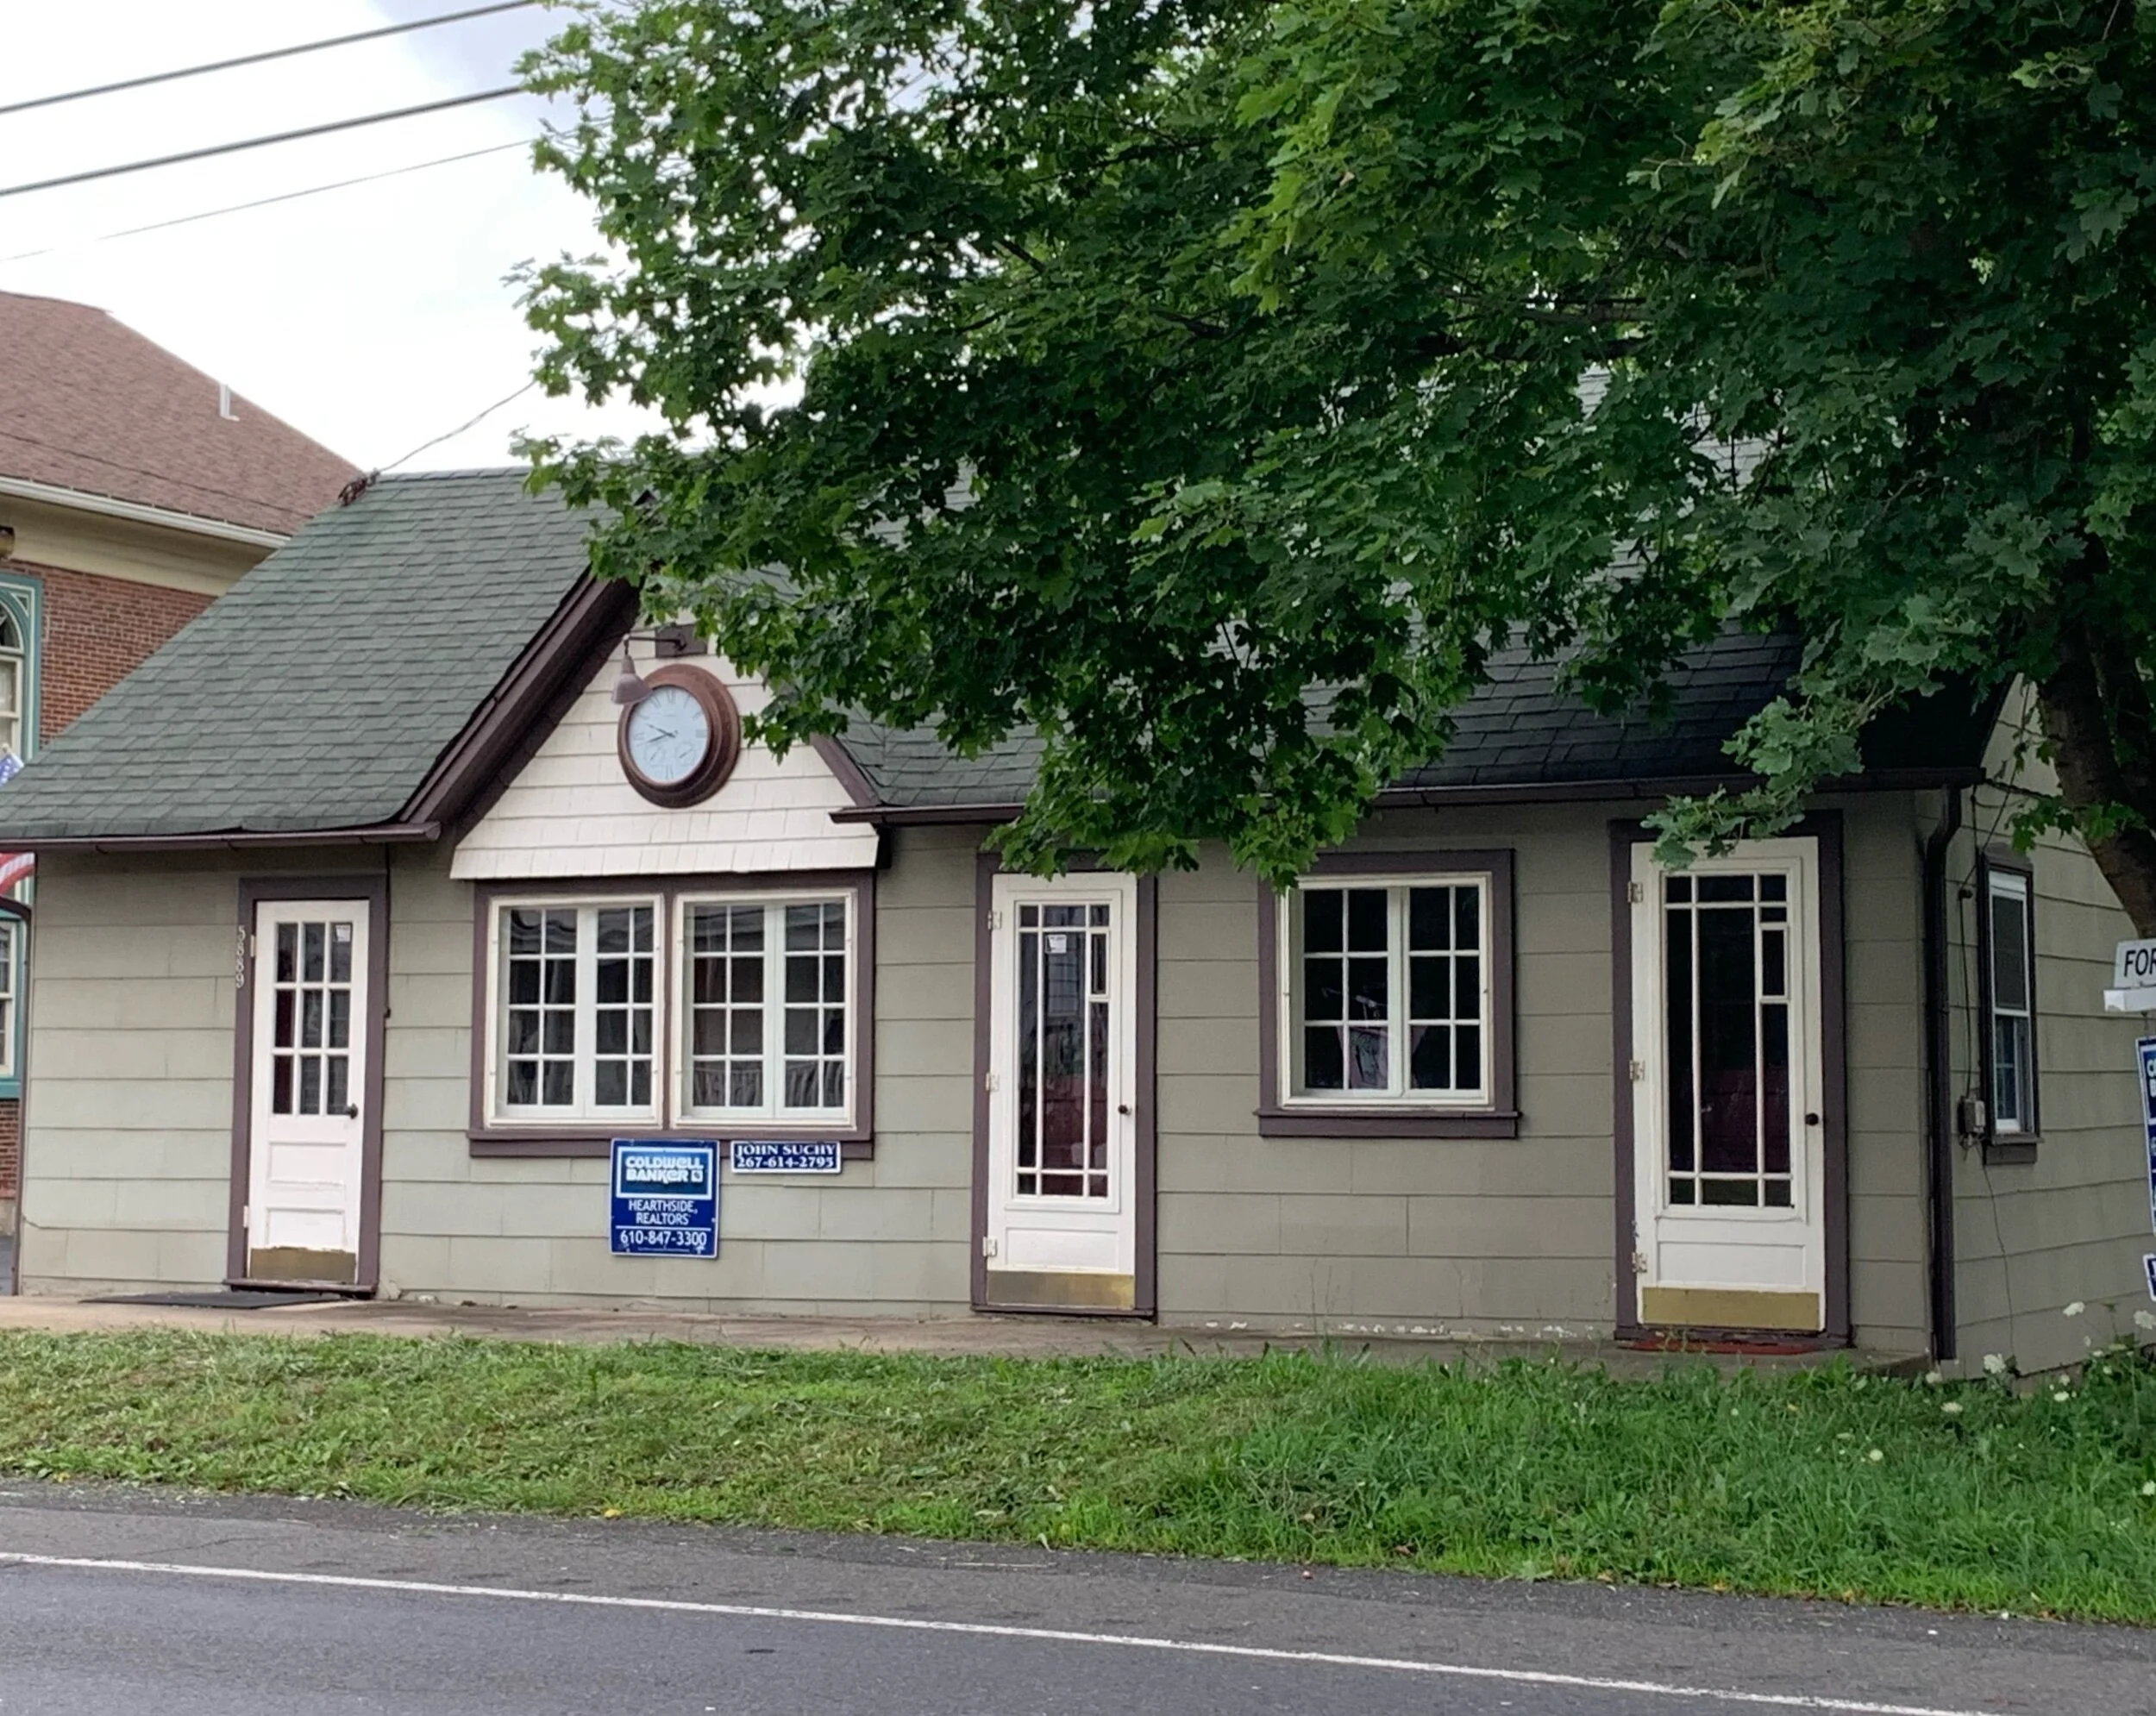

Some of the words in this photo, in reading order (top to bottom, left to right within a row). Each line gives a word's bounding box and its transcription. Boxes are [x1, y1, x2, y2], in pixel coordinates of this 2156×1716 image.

[735, 1144, 779, 1157] JOHN
[782, 1143, 836, 1155] SUCHY
[736, 1155, 835, 1168] 267-614-2795
[620, 1230, 708, 1247] 610-847-3300
